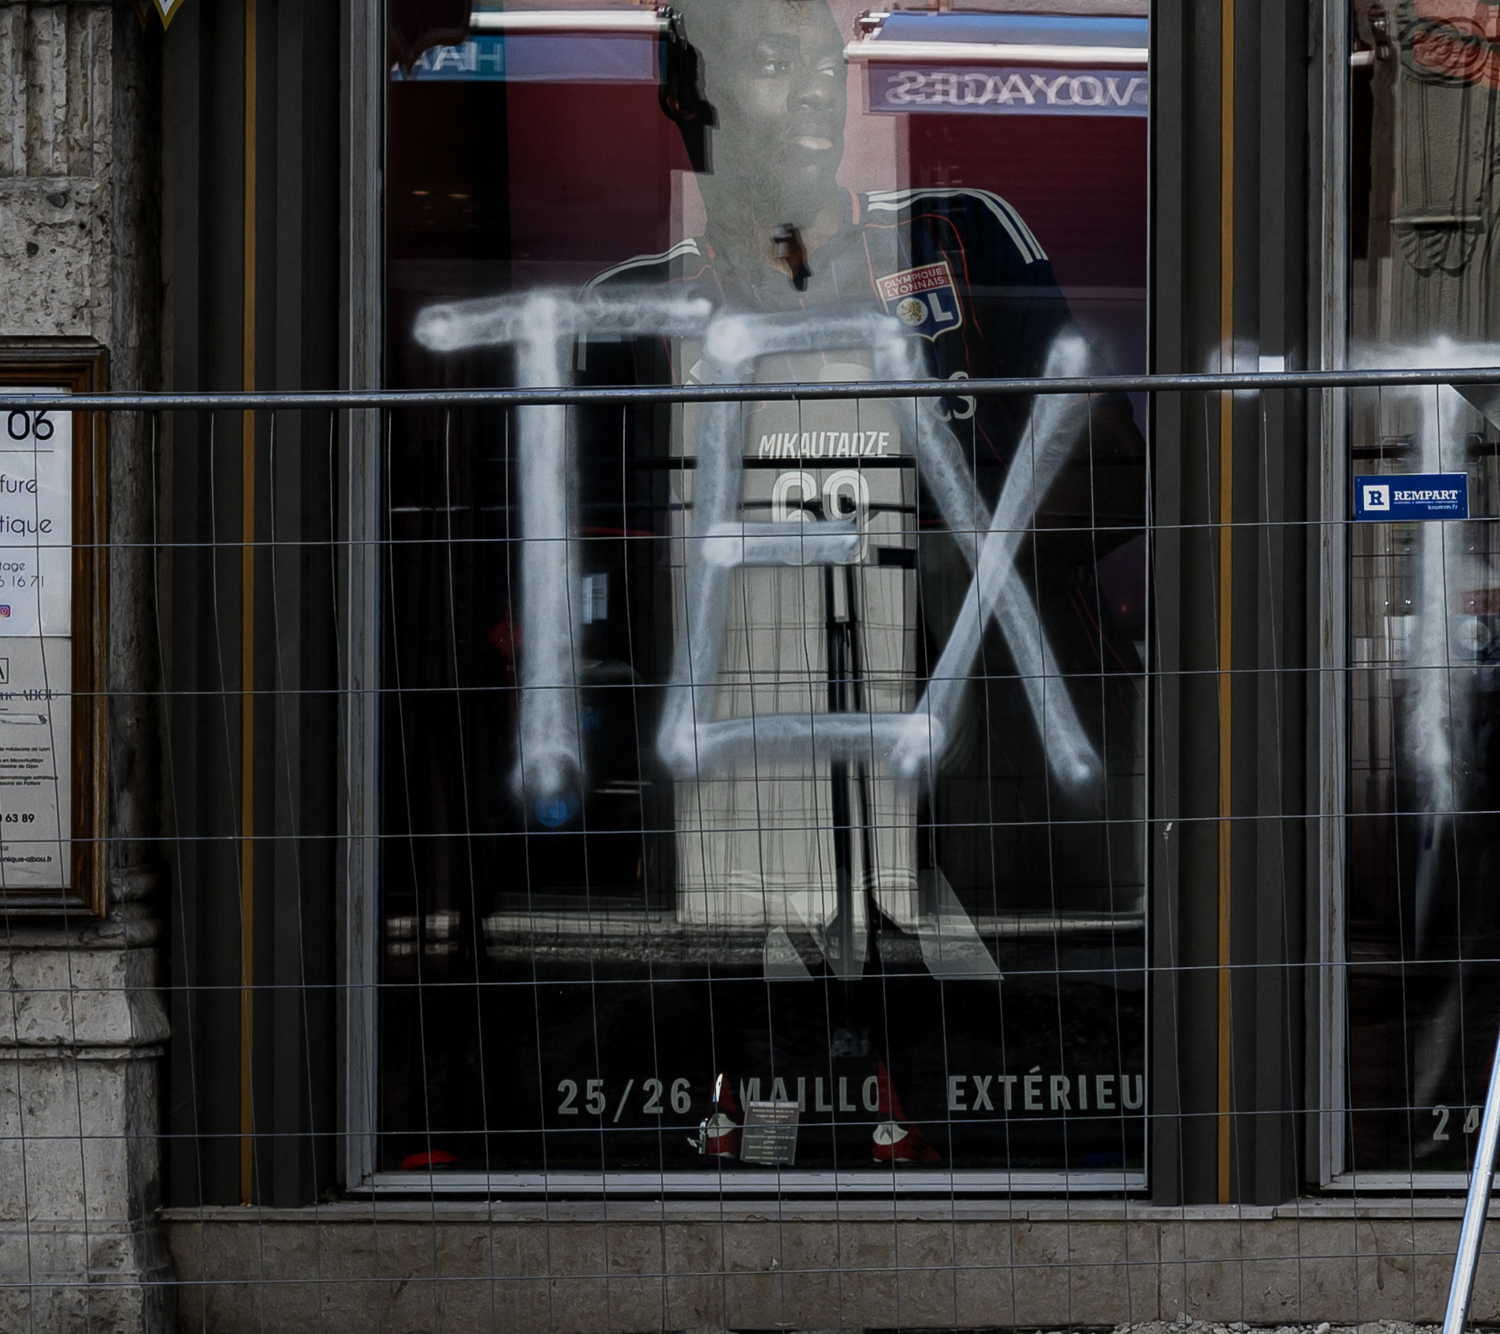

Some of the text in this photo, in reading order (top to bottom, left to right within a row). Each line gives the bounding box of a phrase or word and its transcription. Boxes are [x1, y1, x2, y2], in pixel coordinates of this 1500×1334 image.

[884, 268, 943, 289] OLYMPIQUE
[886, 276, 945, 298] LYONNAIS
[758, 430, 890, 461] MIKAUTADZE
[1393, 490, 1458, 501] REMPART
[5, 813, 35, 823] 63 89
[557, 1076, 692, 1124] 25/26
[740, 1076, 882, 1114] MAILLO
